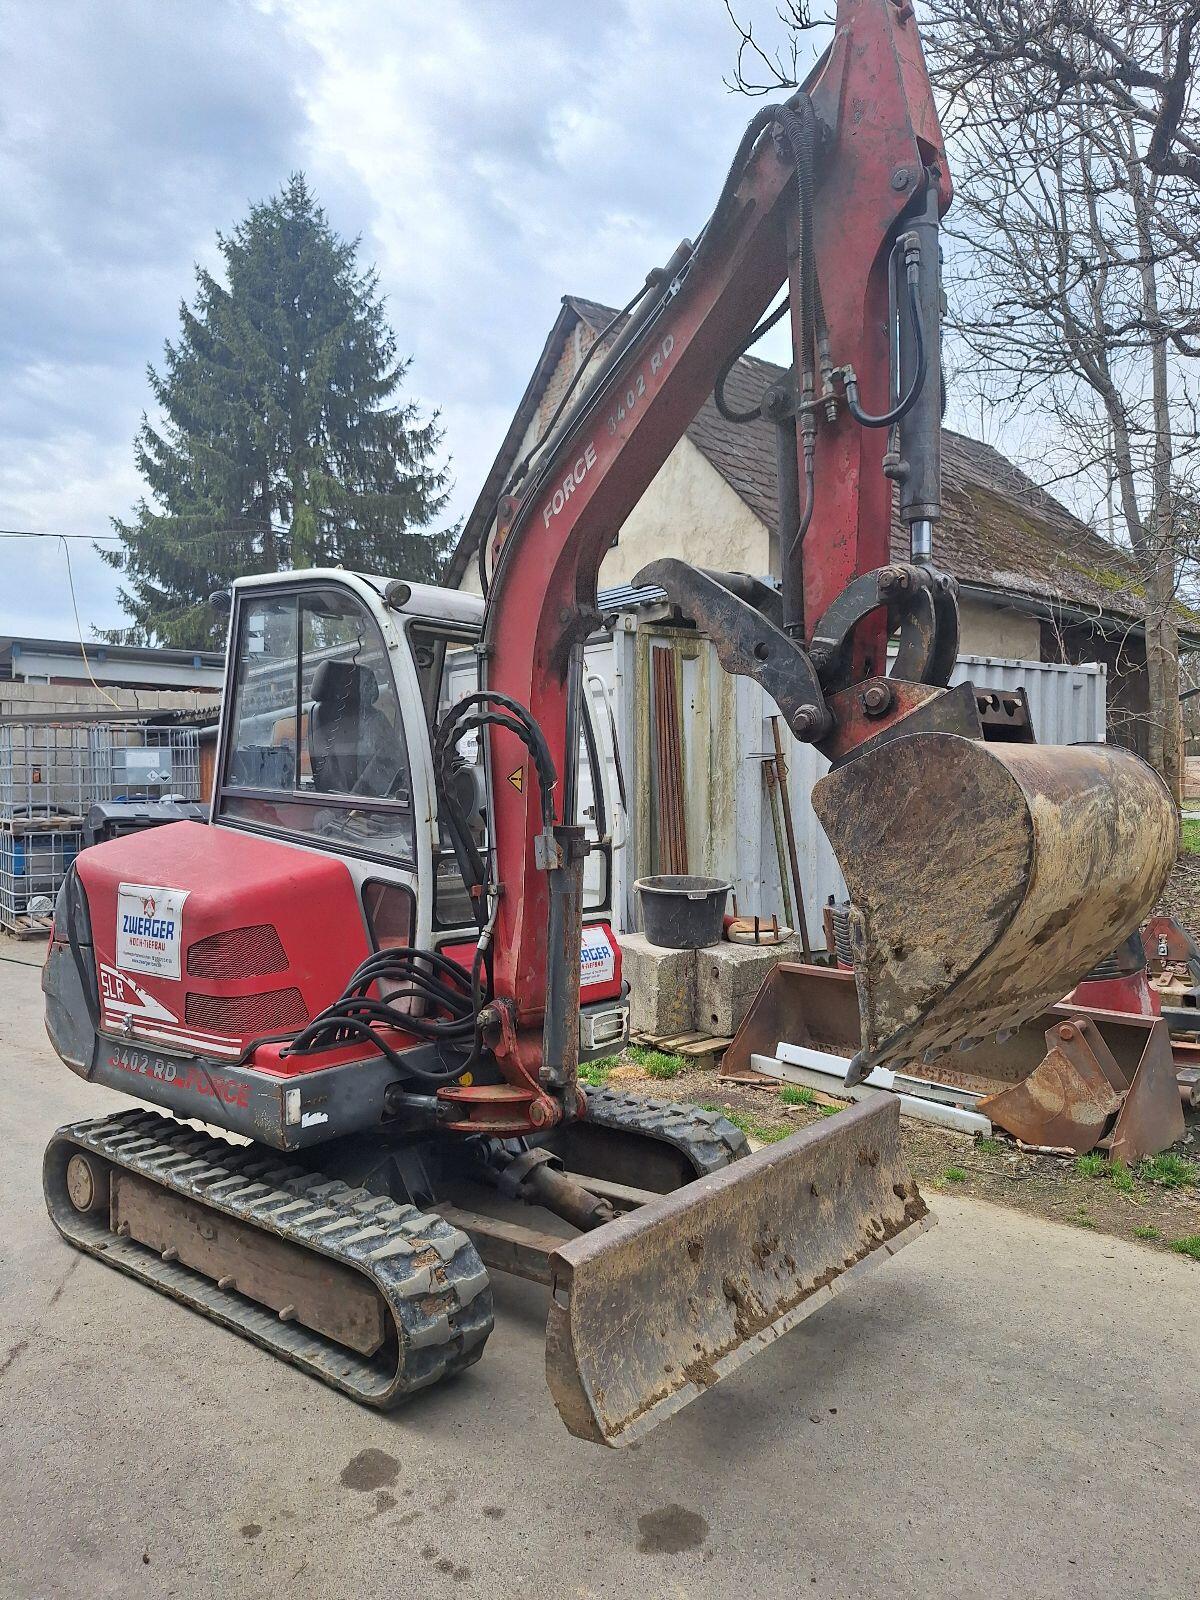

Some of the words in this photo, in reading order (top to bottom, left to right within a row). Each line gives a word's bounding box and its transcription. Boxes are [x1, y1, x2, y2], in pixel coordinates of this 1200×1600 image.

[542, 441, 598, 529] FORCE
[607, 374, 647, 436] 3402
[650, 334, 676, 376] RD
[123, 914, 175, 941] ZWERGER
[101, 972, 125, 1000] SLR
[111, 1047, 149, 1075] 3402
[153, 1058, 177, 1082] RD
